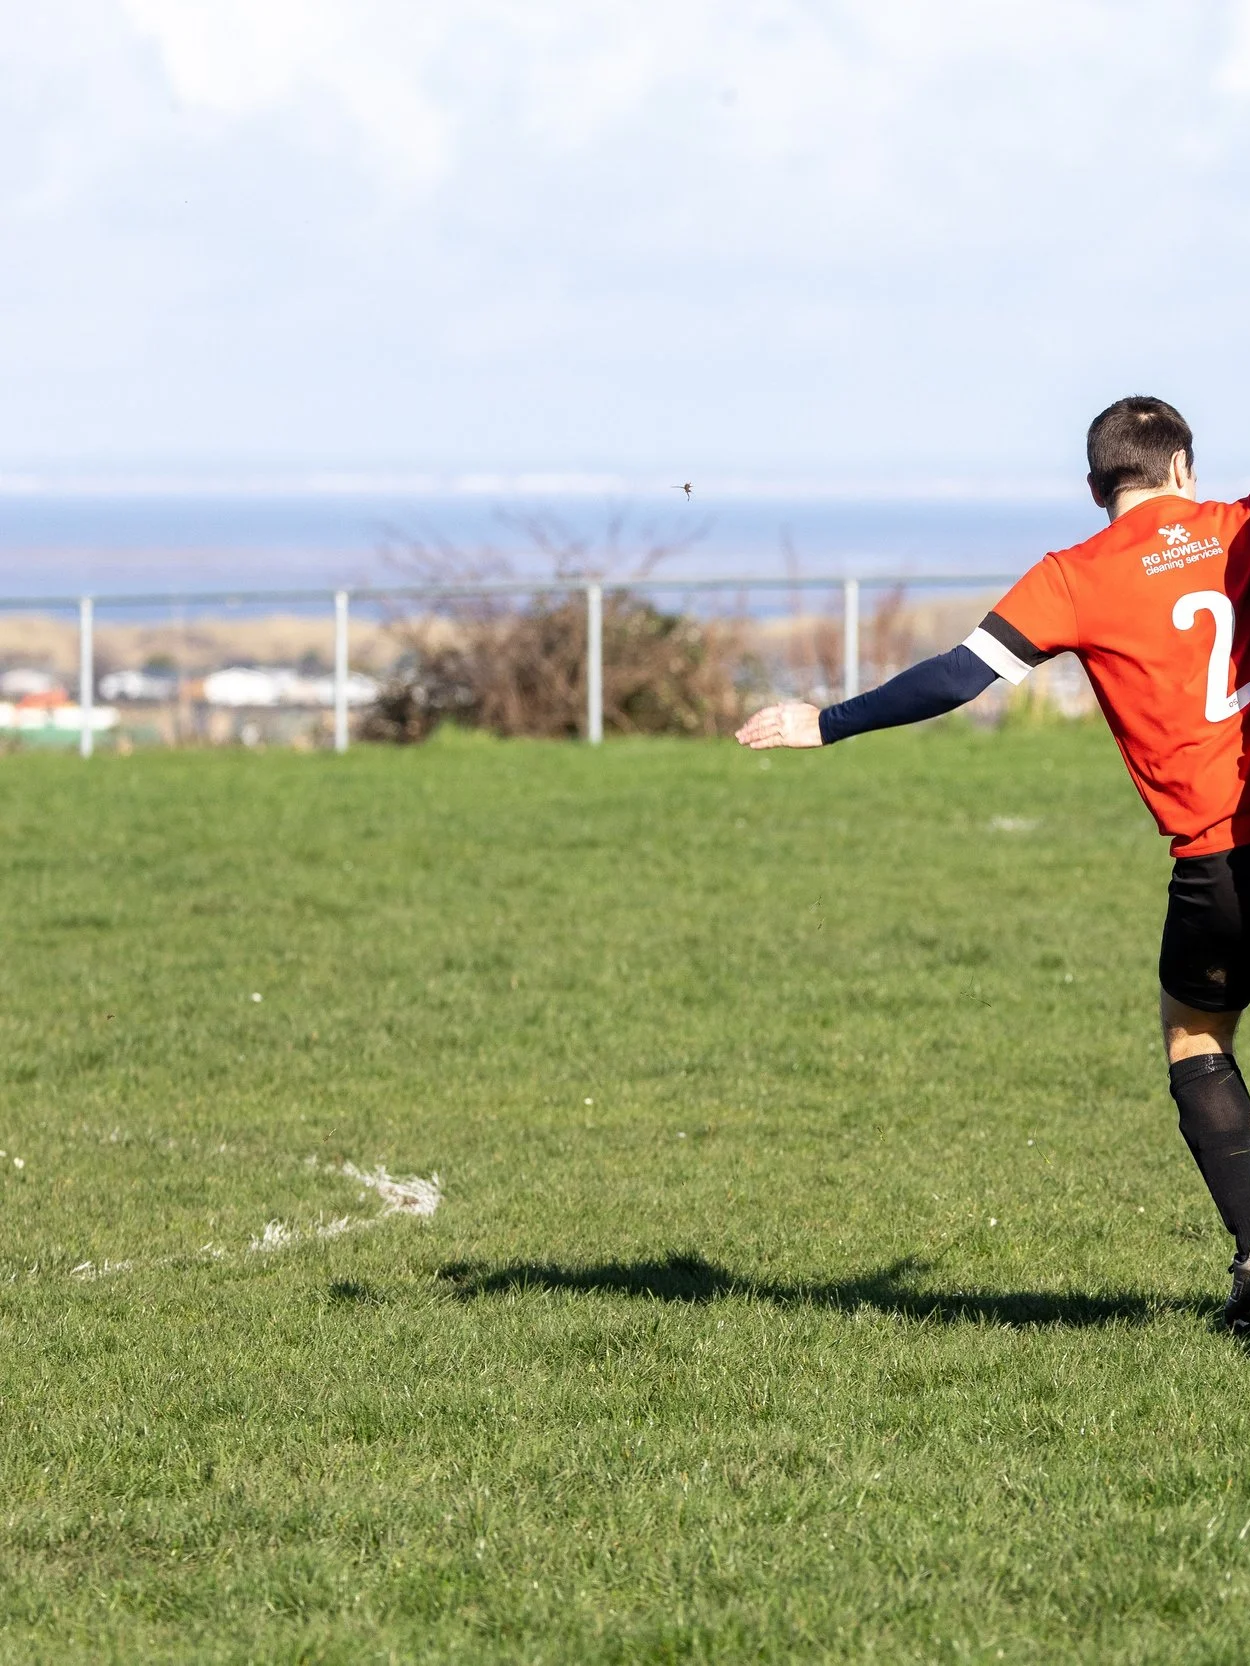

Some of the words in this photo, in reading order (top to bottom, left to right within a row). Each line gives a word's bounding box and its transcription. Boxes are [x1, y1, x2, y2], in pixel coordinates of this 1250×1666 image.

[1141, 553, 1161, 568] RG
[1162, 536, 1220, 561] HOWELLS
[1145, 558, 1185, 576] cleaning
[1185, 547, 1224, 564] services
